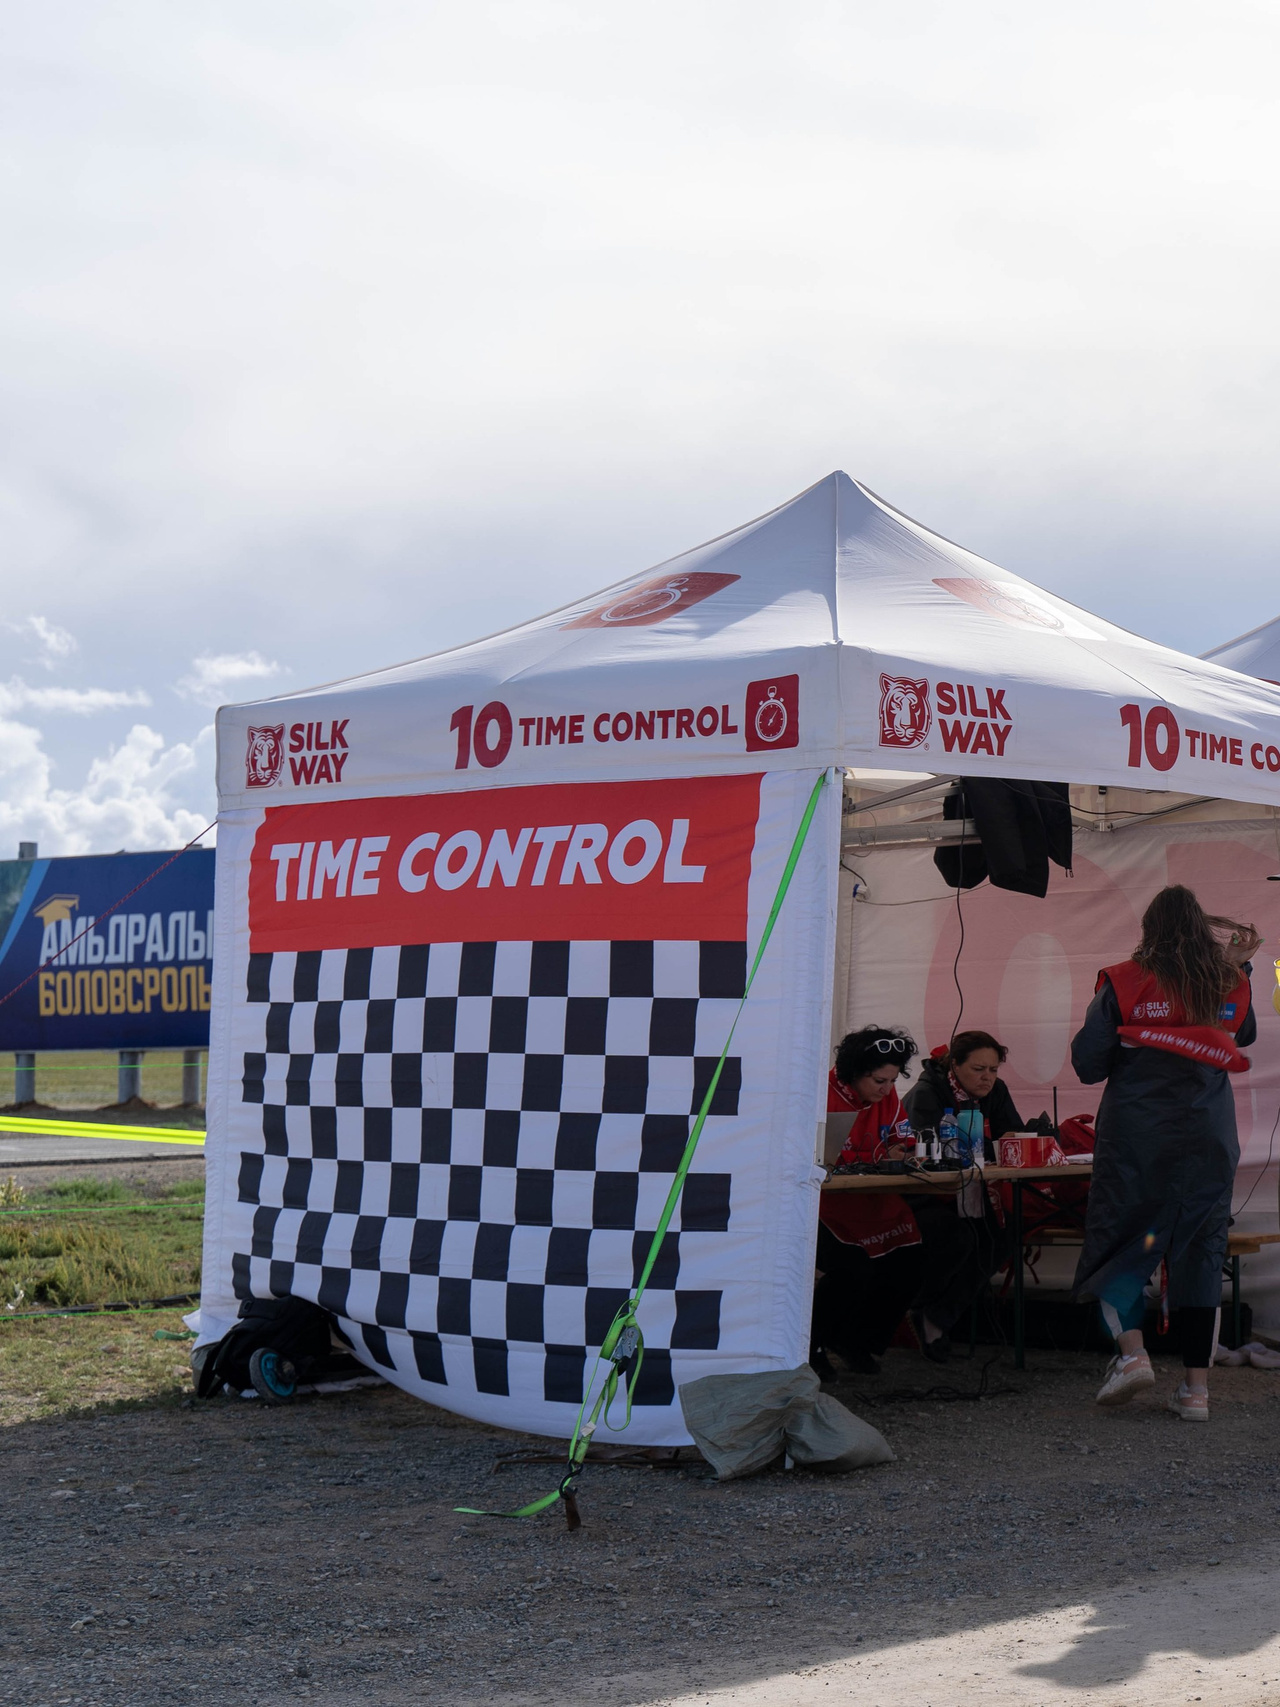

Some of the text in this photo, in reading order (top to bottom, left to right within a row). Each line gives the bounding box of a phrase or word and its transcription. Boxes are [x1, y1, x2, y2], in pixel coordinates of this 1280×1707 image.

[936, 682, 1012, 721] SILK
[288, 719, 349, 752] SILK
[450, 702, 738, 769] 10 TIME CONTROL
[938, 718, 1012, 756] WAY
[1119, 703, 1180, 771] 10
[1185, 729, 1243, 766] TIME
[289, 752, 348, 786] WAY
[269, 818, 707, 902] TIME CONTROL
[1146, 1001, 1170, 1010] SILK
[1147, 1009, 1170, 1018] WAY
[1140, 1030, 1233, 1064] #silkwayrally
